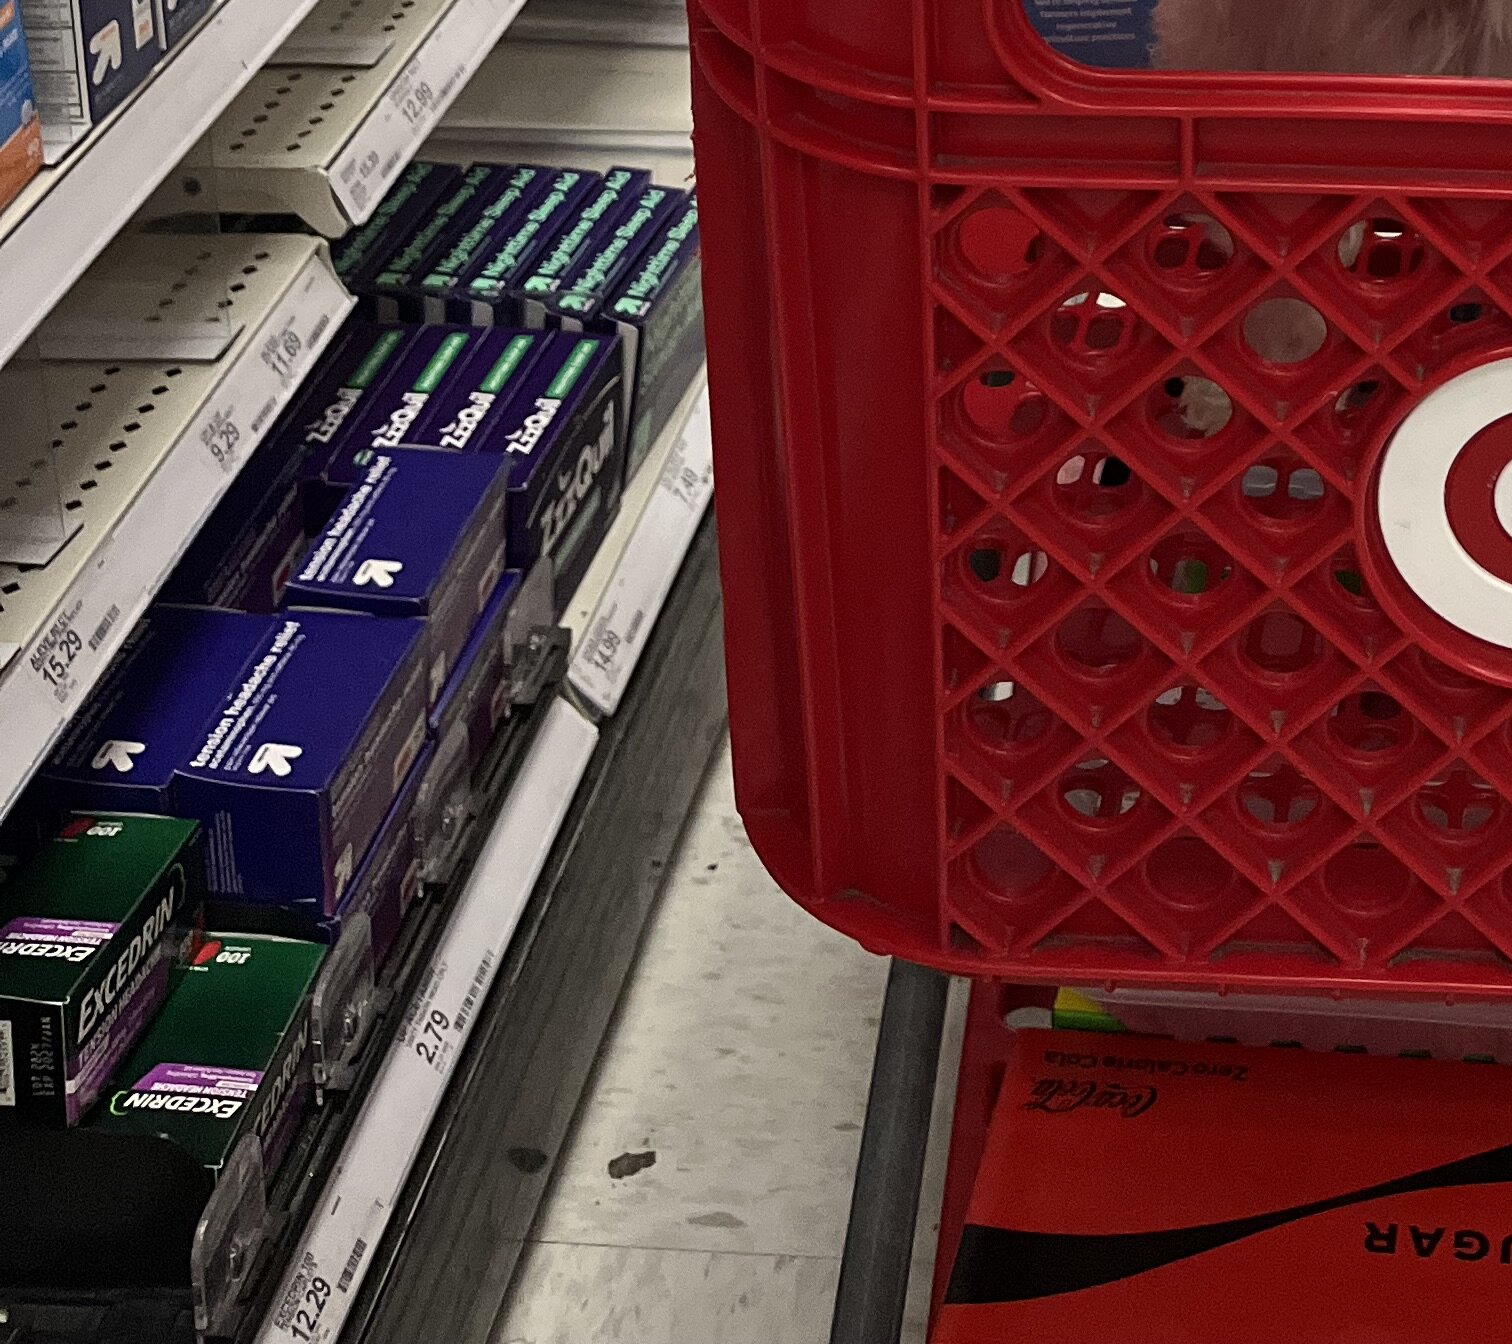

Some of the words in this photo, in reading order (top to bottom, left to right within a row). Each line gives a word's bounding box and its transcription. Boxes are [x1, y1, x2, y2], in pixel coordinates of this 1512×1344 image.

[400, 81, 434, 124] 12.99
[209, 421, 241, 463] 9.29
[42, 628, 83, 688] 15.29
[189, 717, 235, 767] tension
[223, 654, 278, 716] headache
[76, 885, 175, 1046] EXCEDRIN
[215, 951, 252, 965] 100
[415, 1008, 451, 1066] 2.79
[258, 1018, 309, 1136] EDRIN
[1042, 1050, 1097, 1070] Cola
[1100, 1053, 1191, 1078] Calorie
[1194, 1061, 1250, 1083] Zero
[123, 1091, 243, 1119] EXCEDRIN
[290, 1276, 333, 1342] 12.29
